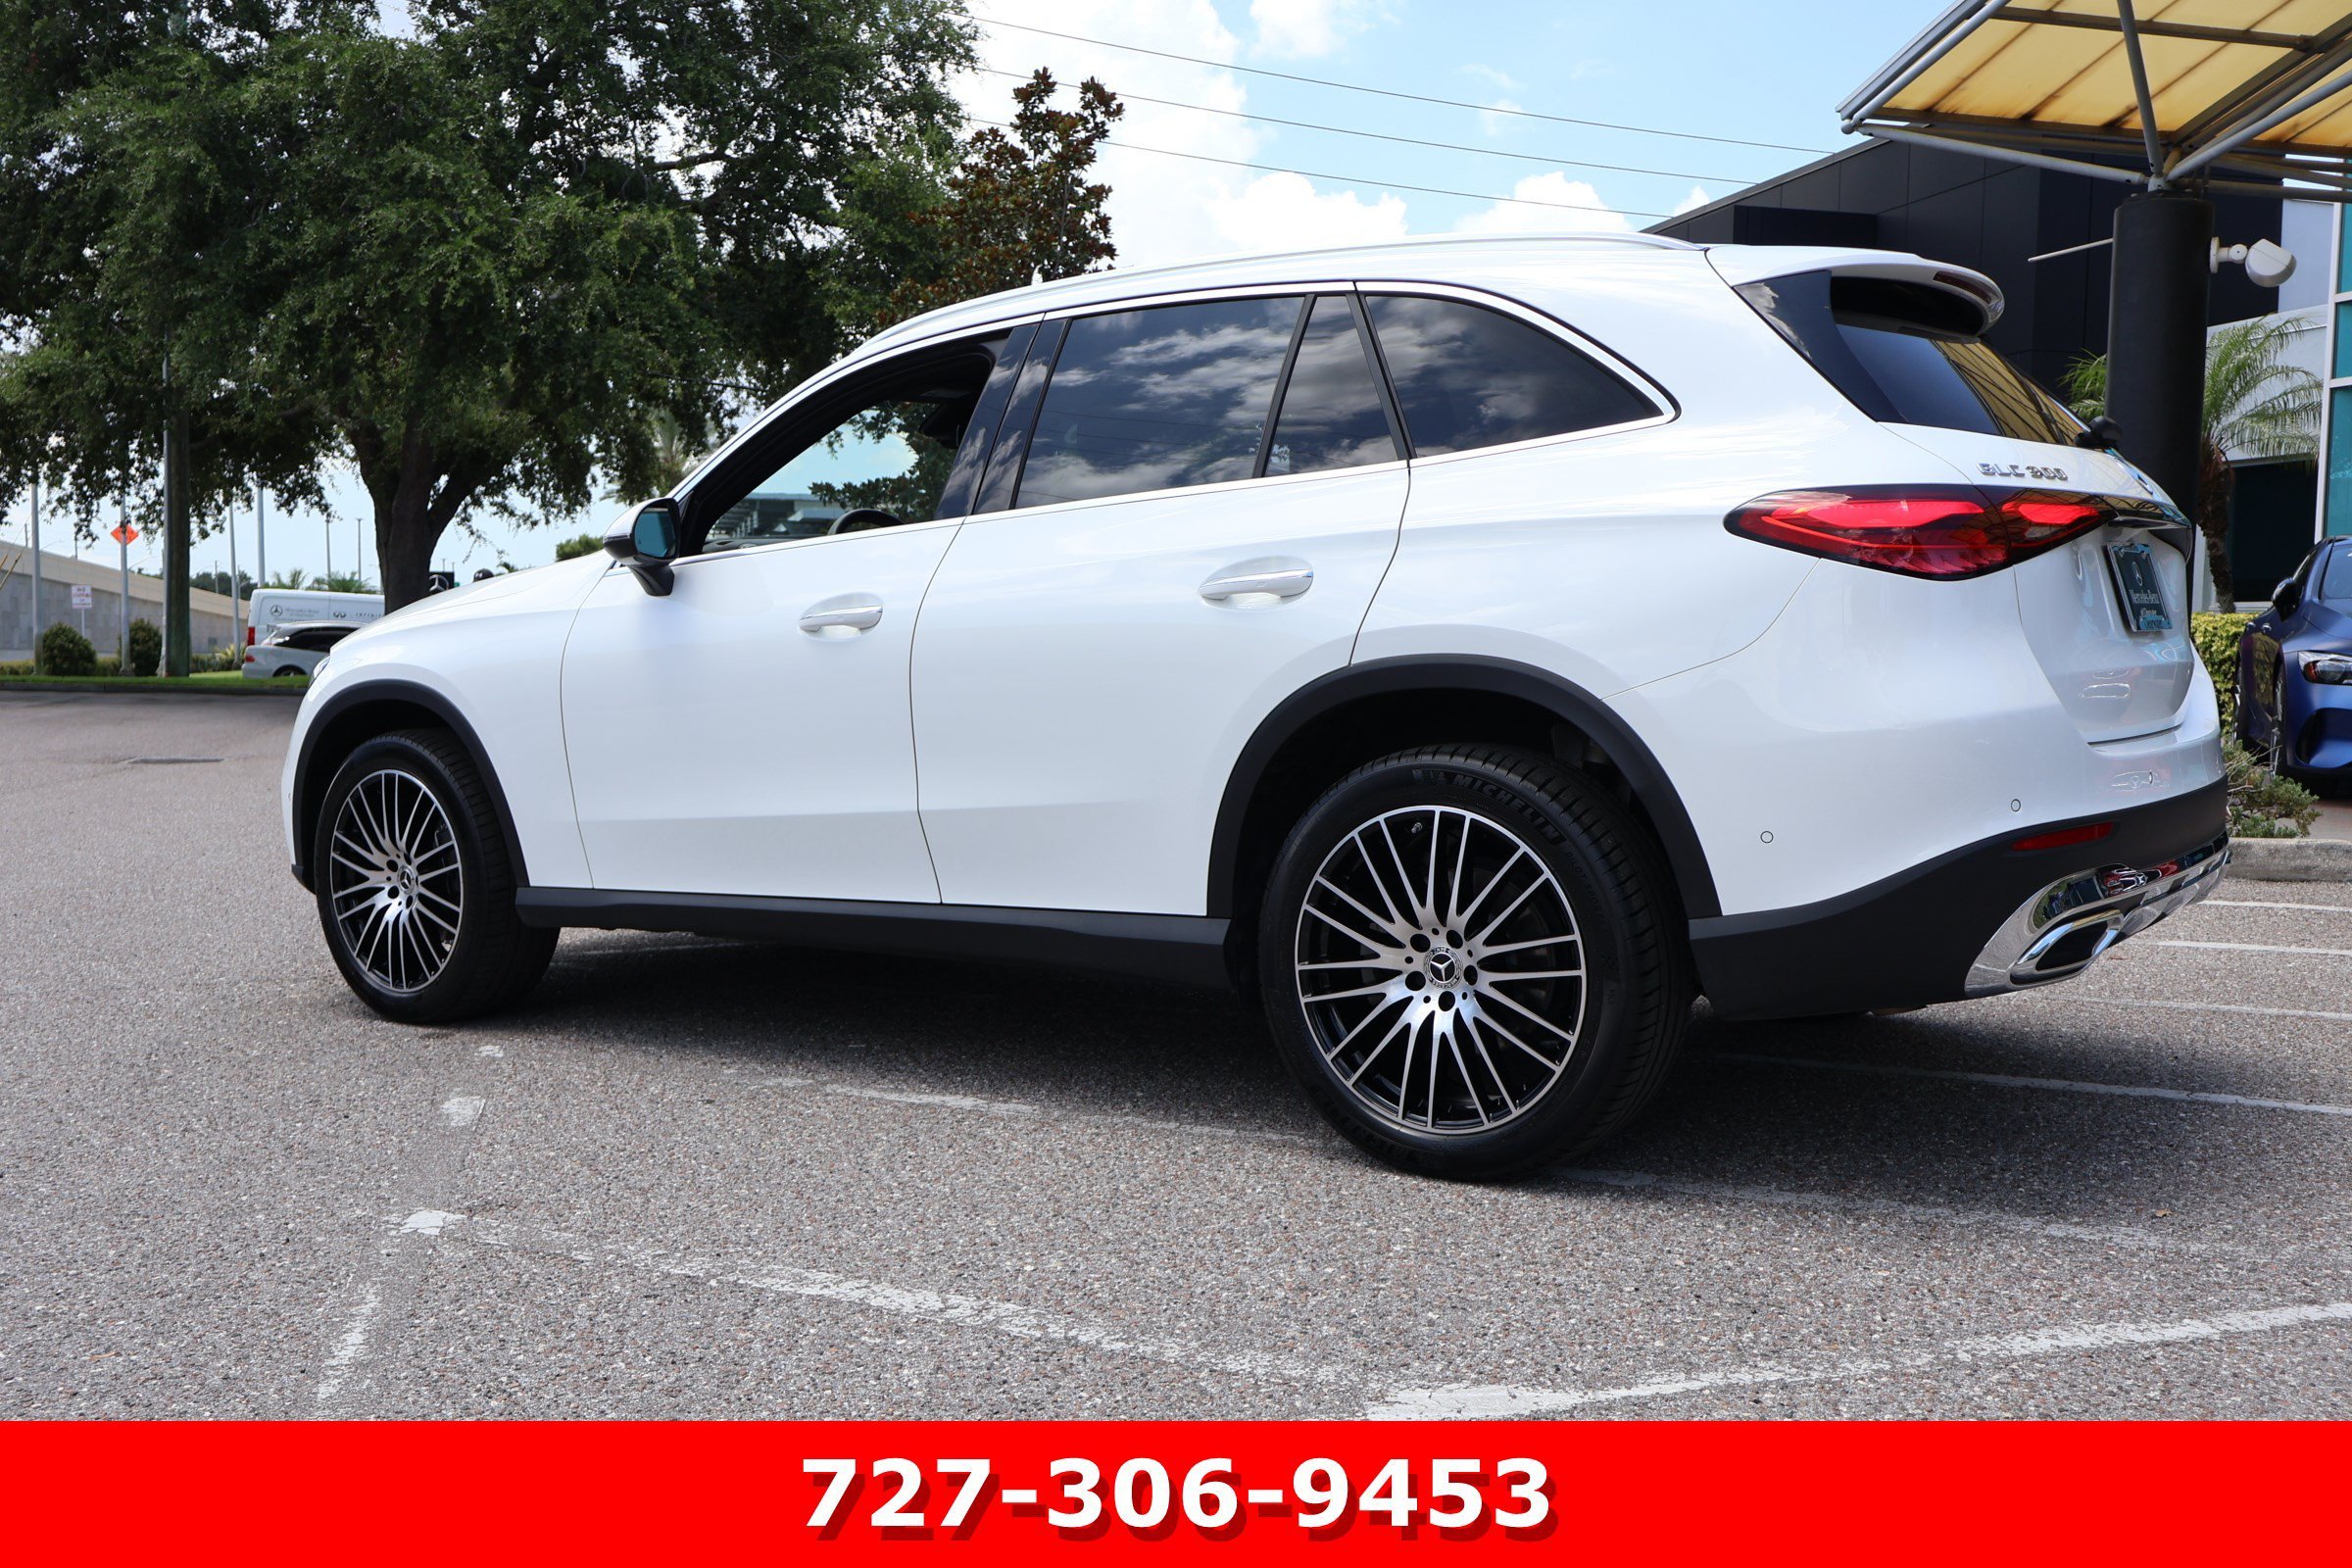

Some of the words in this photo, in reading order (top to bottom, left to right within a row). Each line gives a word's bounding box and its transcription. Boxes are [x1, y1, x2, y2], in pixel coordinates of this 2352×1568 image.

[1976, 463, 2025, 477] GLC
[2026, 466, 2068, 480] 300
[1452, 773, 1563, 843] MICHELIN
